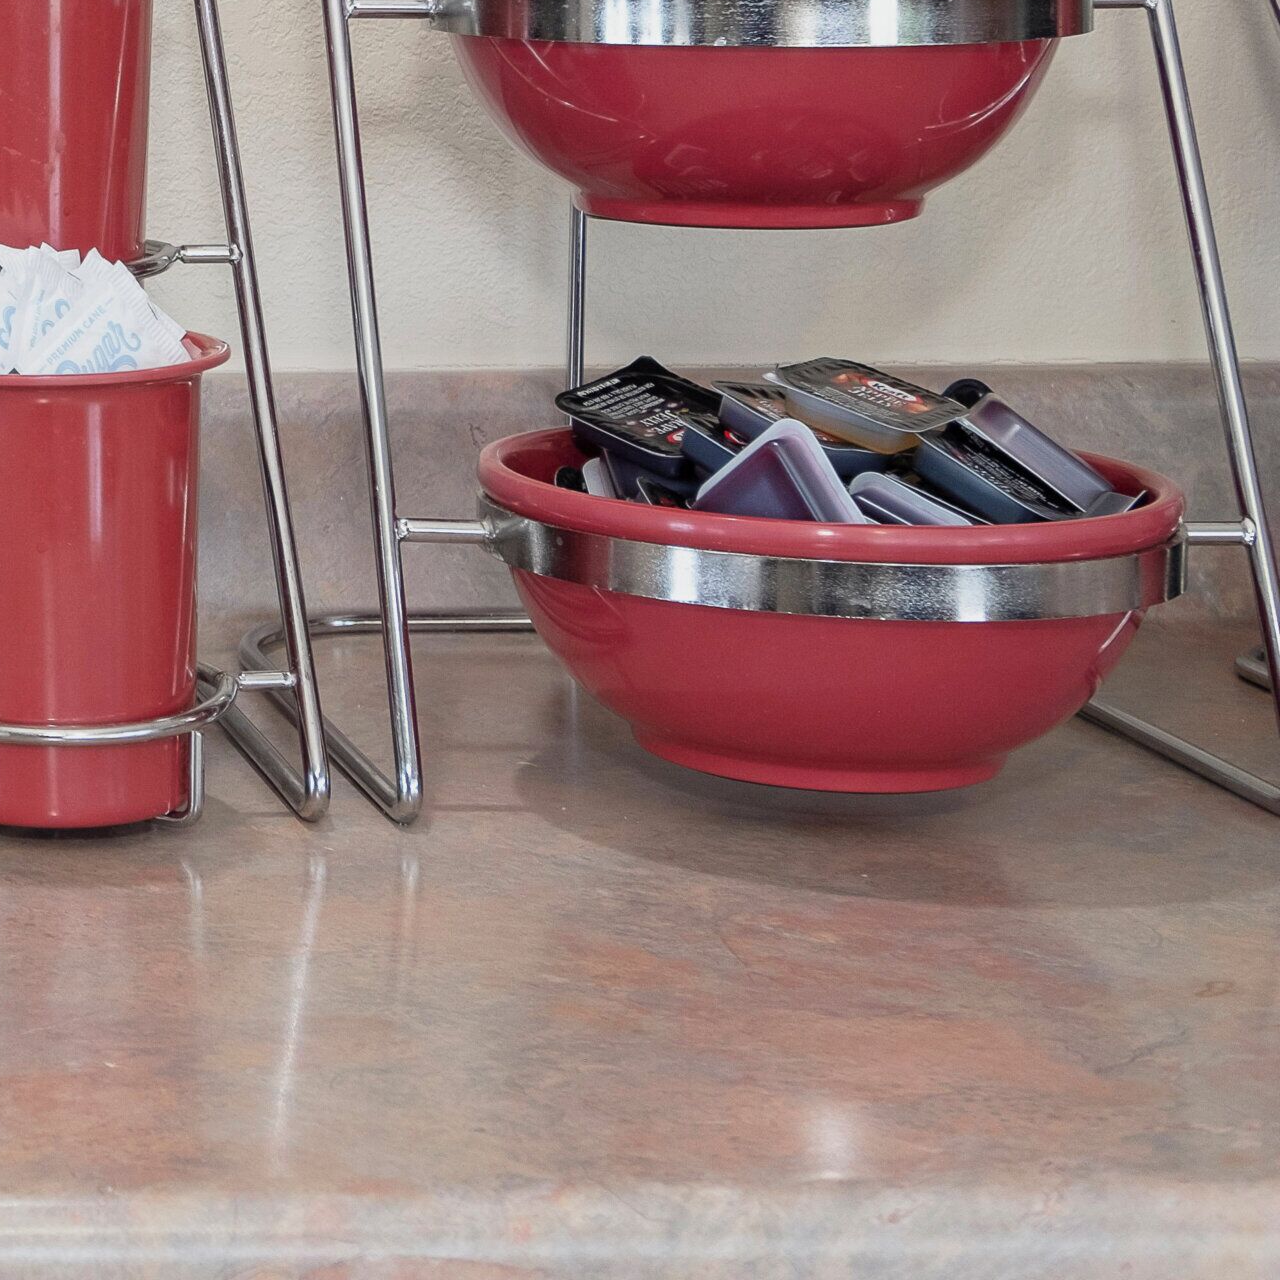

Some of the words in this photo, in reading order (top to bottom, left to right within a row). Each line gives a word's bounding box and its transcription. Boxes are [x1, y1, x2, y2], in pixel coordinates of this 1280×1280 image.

[46, 328, 85, 365] PREMIUM
[83, 304, 106, 329] CANE
[651, 420, 685, 435] RAPE
